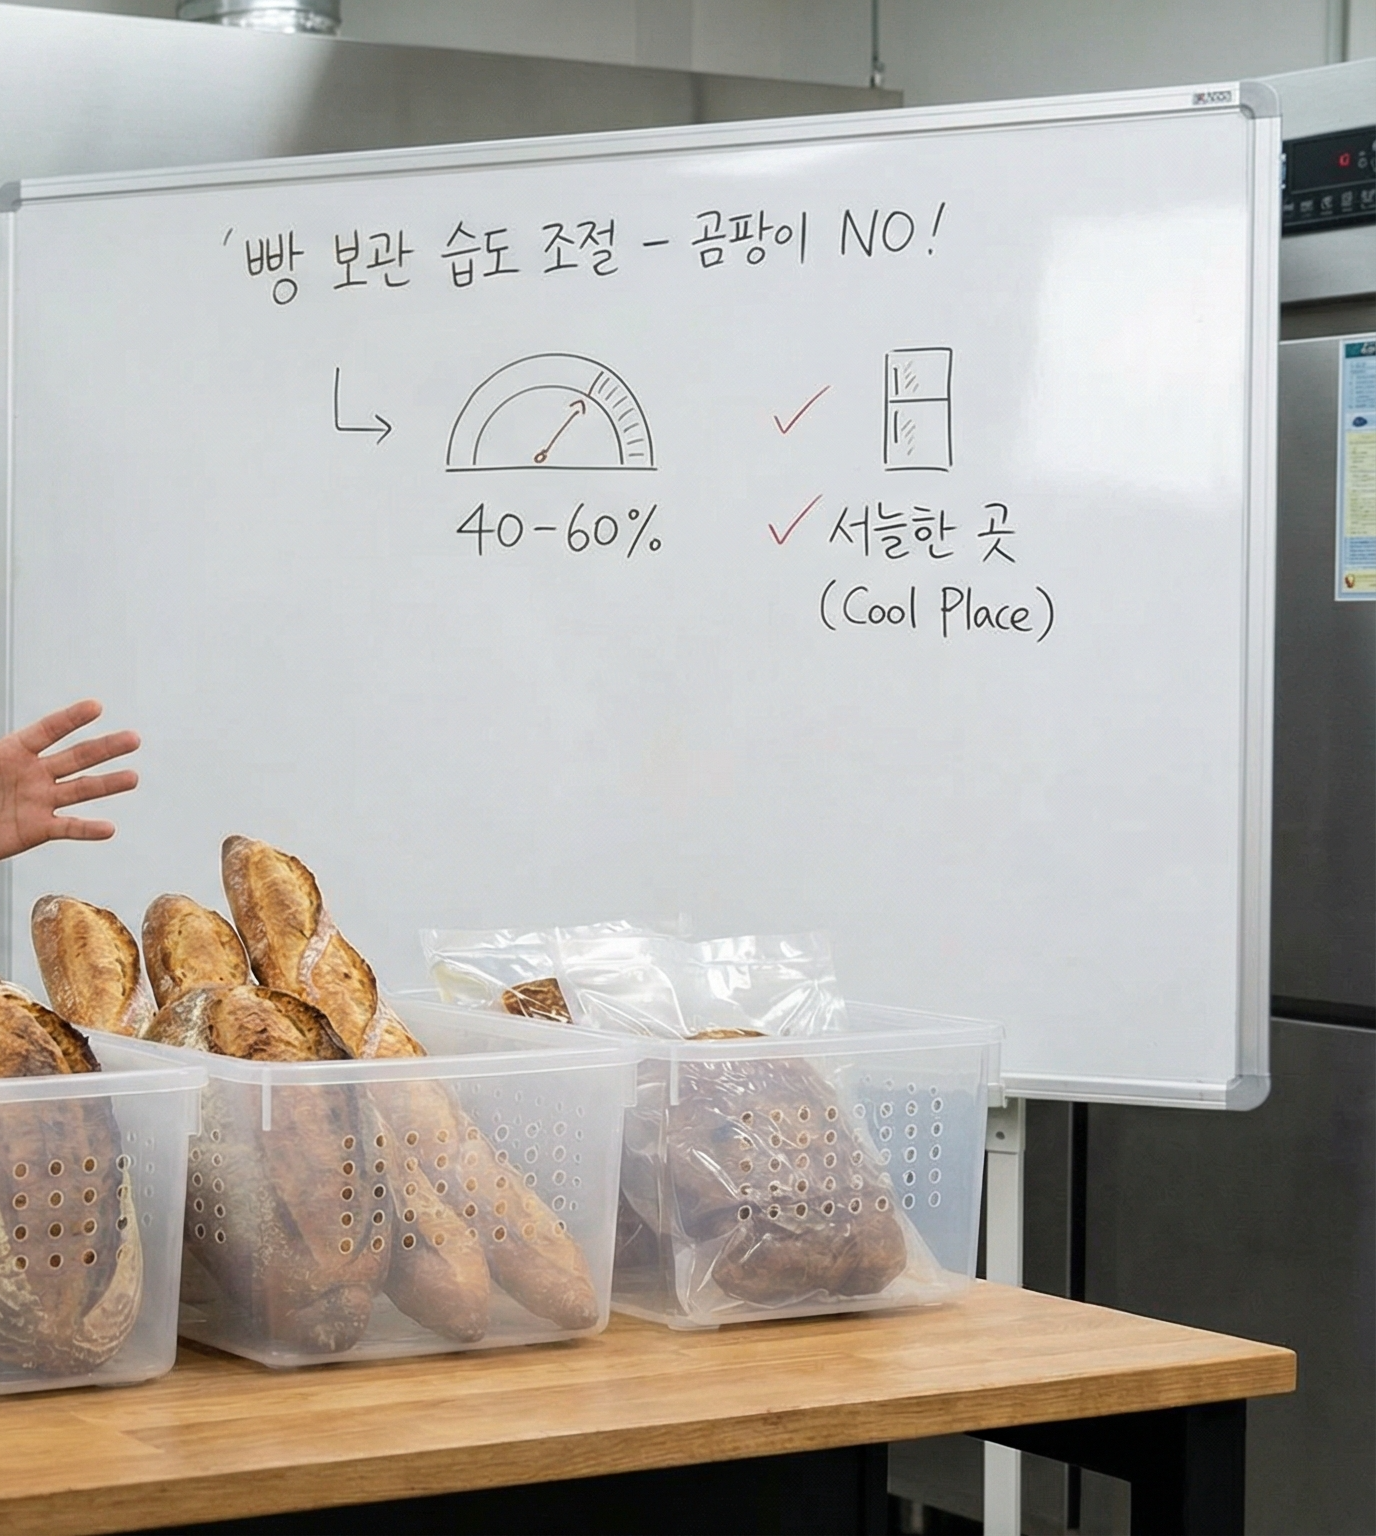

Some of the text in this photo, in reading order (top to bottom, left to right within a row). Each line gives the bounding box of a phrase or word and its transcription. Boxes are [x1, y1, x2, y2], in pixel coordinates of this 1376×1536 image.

[333, 229, 414, 290] 보관
[441, 221, 521, 287] 습도
[542, 219, 618, 276] 조절
[692, 210, 806, 268] 곰팡이
[841, 202, 945, 257] NO!
[456, 503, 661, 558] 40-60%
[829, 502, 1015, 563] 서늘한 곳
[821, 579, 1054, 642] (Cool Place)
